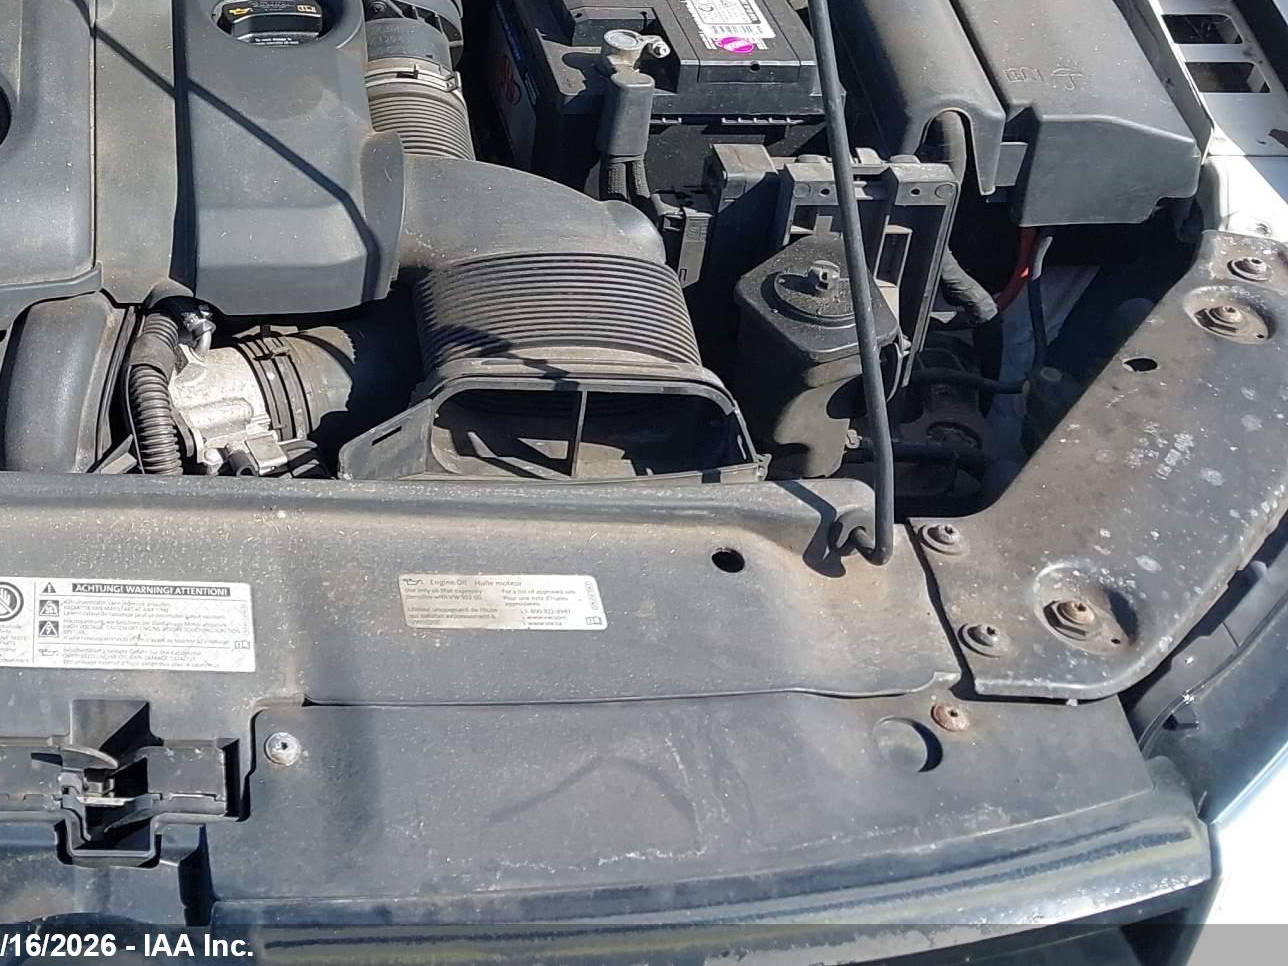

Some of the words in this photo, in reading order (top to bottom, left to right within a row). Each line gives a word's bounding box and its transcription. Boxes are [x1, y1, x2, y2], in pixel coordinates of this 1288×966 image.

[75, 584, 124, 594] ACHTUNG!
[125, 585, 174, 595] WARNING!
[174, 586, 228, 596] ATTENTION!
